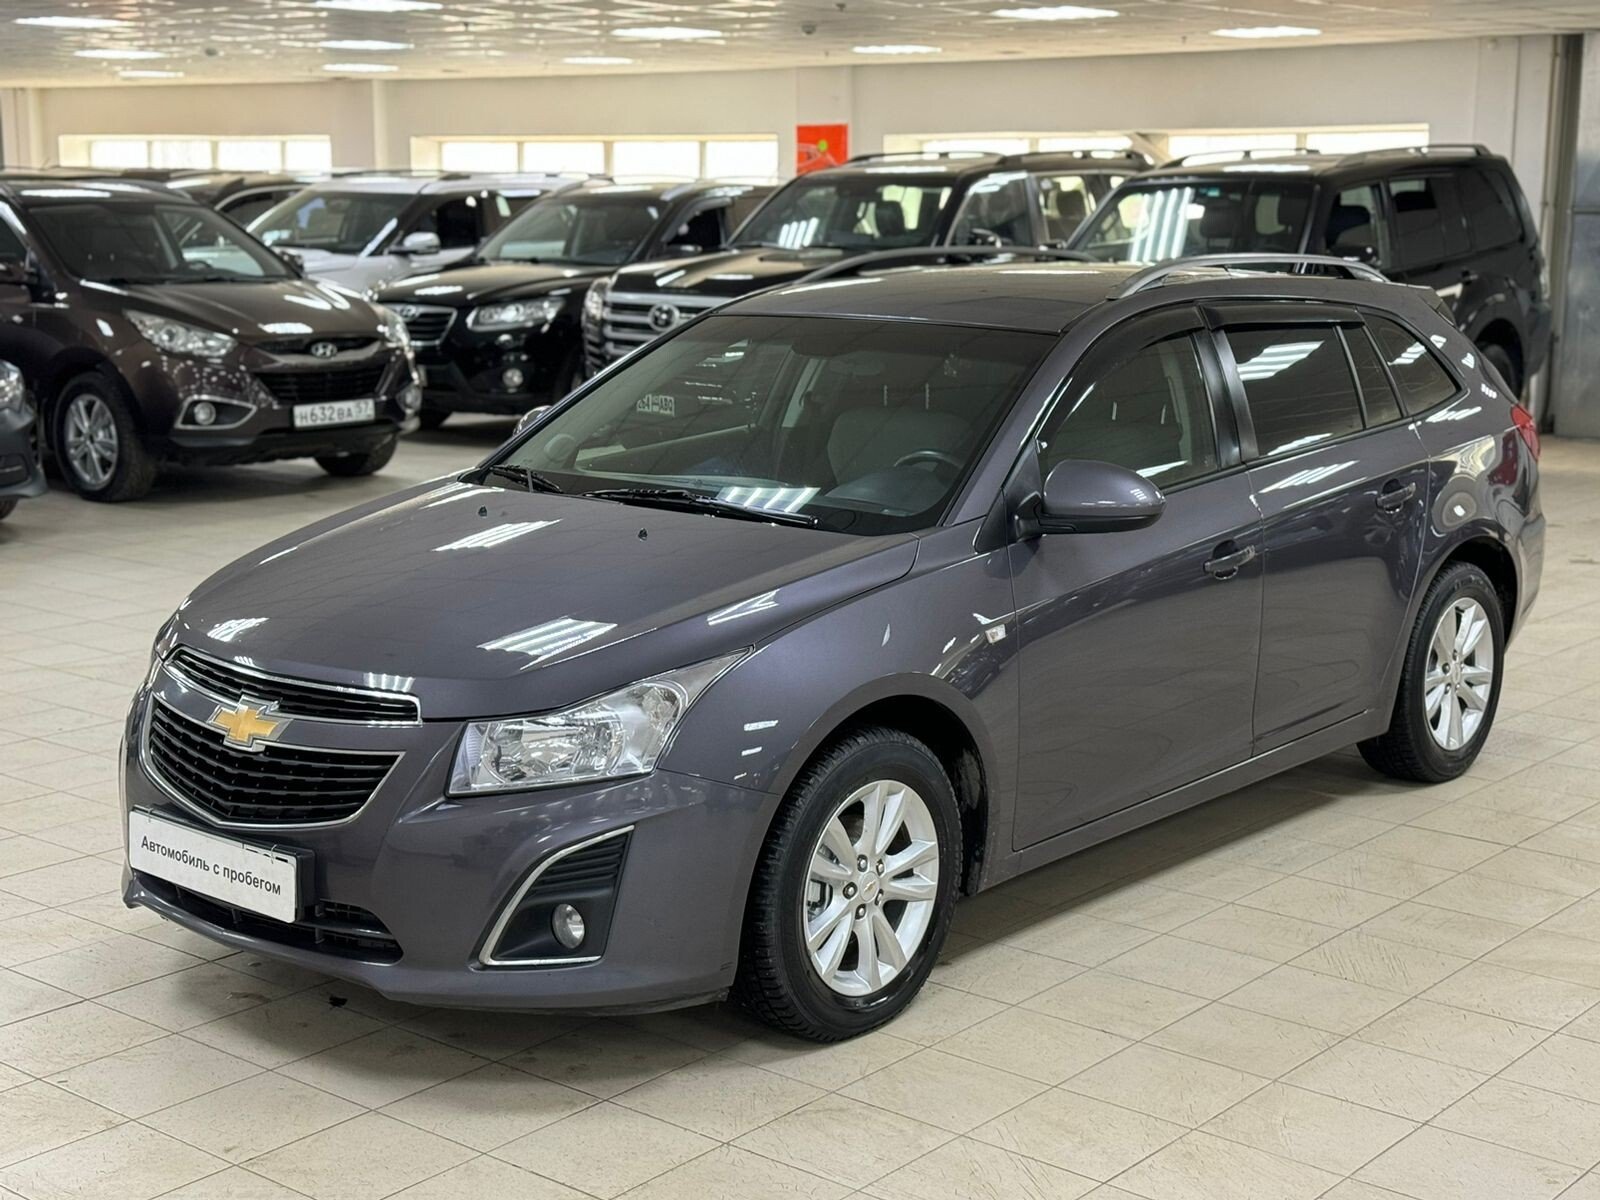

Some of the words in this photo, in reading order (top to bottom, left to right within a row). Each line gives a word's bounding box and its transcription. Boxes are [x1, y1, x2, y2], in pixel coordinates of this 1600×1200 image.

[141, 835, 210, 871] Автомобиль
[213, 864, 219, 874] с
[223, 867, 281, 895] пробегом
